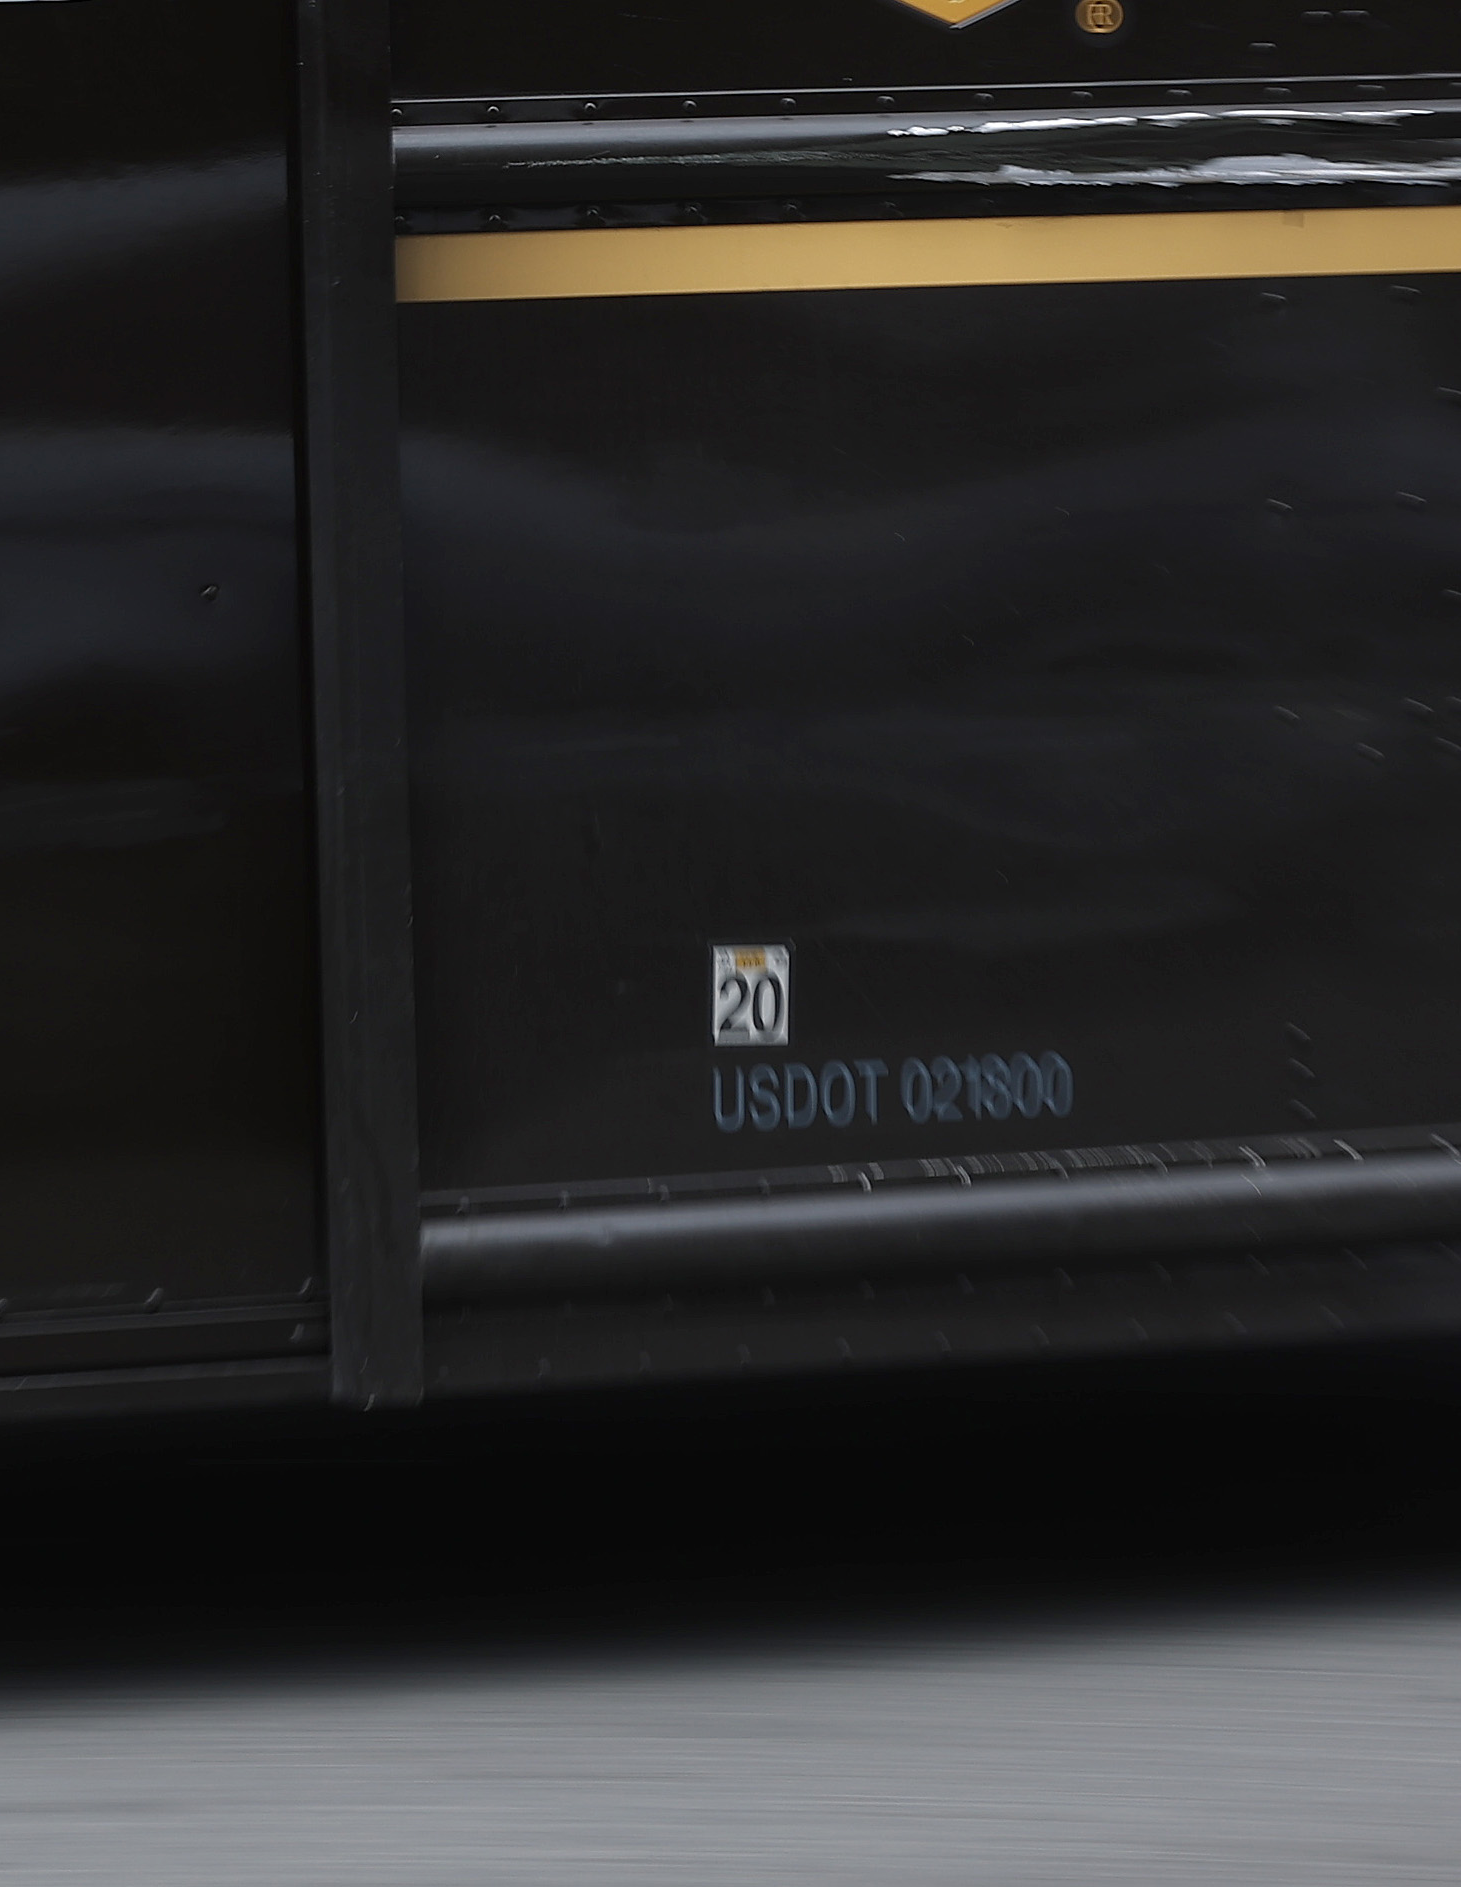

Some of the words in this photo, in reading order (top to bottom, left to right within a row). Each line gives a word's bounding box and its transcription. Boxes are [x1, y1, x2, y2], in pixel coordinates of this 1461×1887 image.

[719, 974, 784, 1042] 20
[713, 1058, 888, 1132] USDOT
[900, 1050, 1074, 1125] 021800
